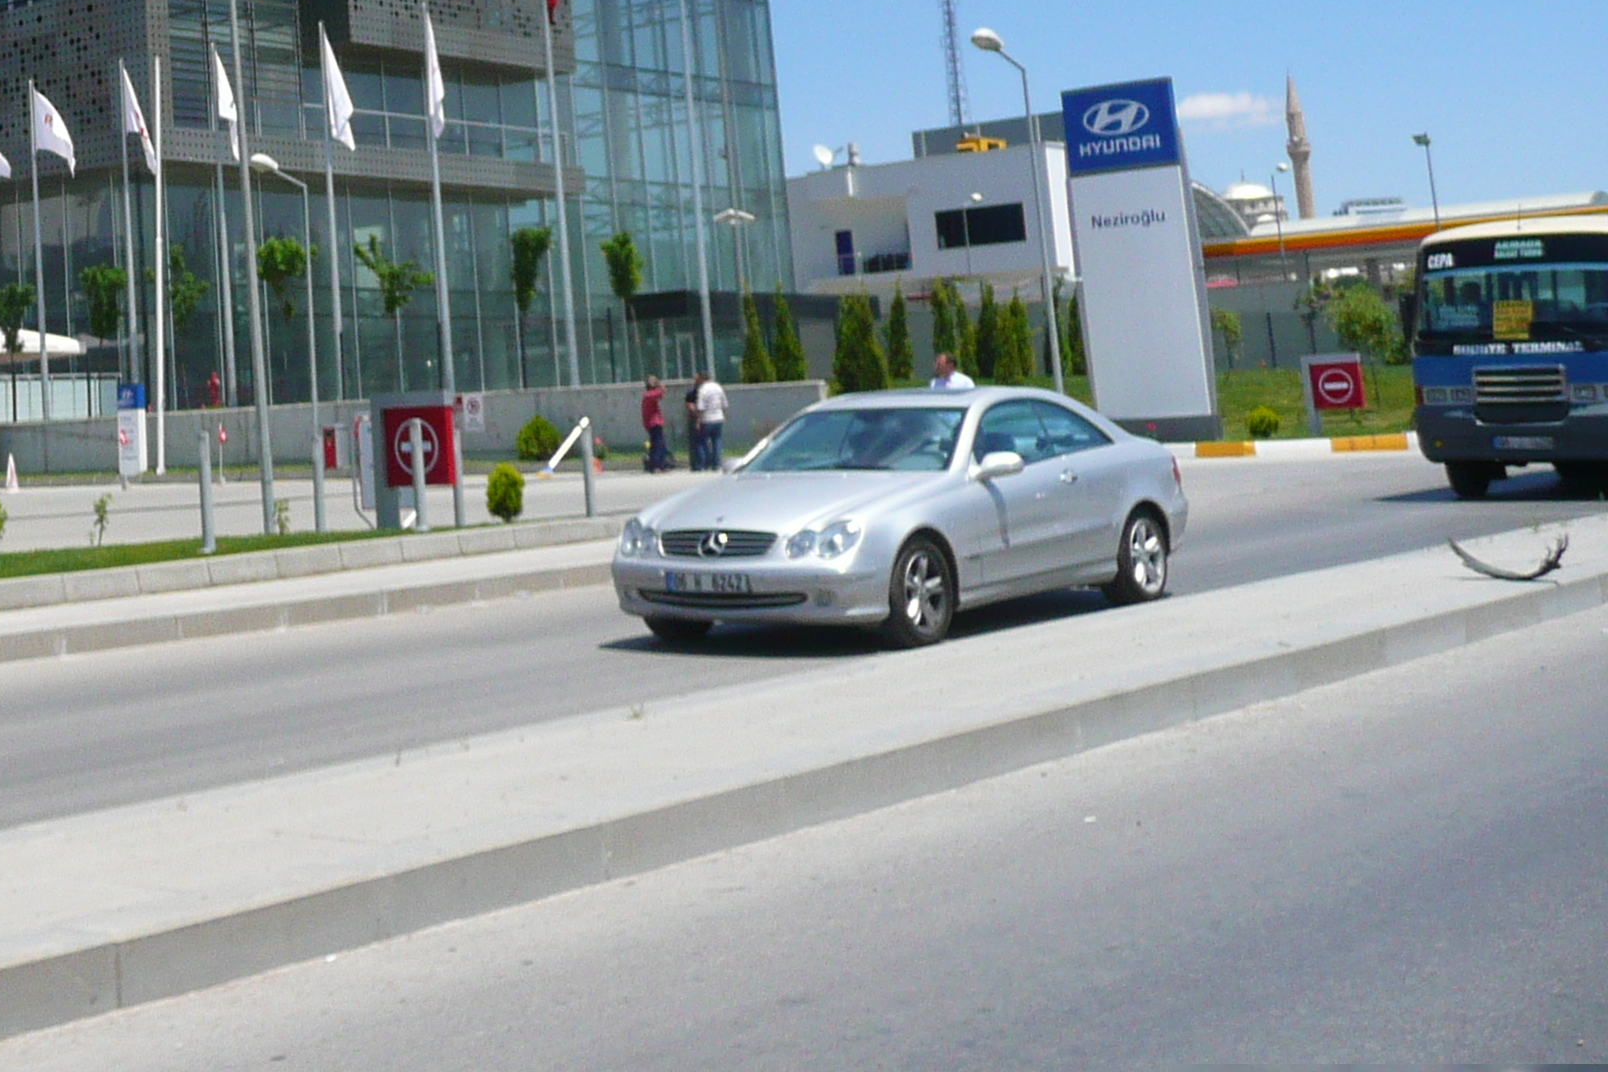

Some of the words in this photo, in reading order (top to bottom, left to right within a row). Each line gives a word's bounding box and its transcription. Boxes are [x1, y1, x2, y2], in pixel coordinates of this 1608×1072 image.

[1079, 134, 1161, 157] HYUNDAI
[1091, 209, 1166, 229] Neziroğlu
[1427, 253, 1453, 269] CEPA
